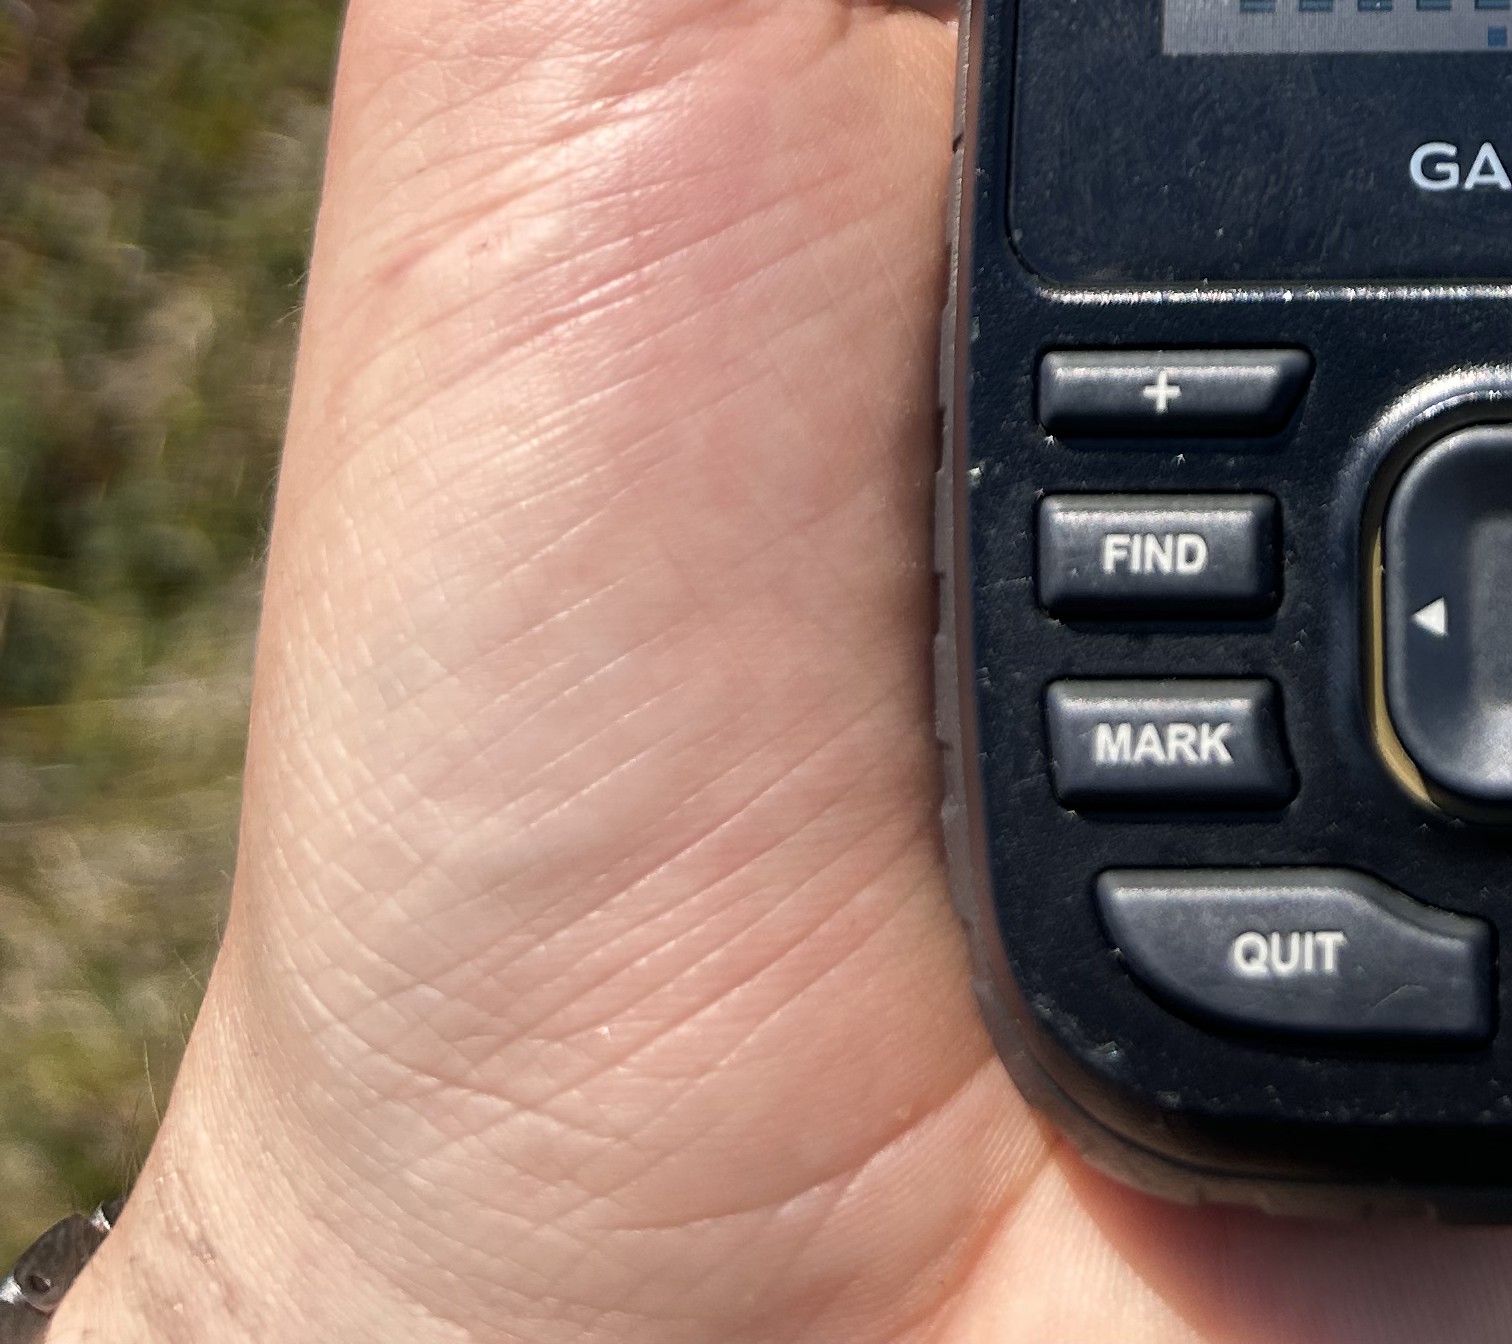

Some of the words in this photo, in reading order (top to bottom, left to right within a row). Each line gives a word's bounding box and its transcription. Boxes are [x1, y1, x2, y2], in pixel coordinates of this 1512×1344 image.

[1102, 533, 1209, 576] FIND
[1094, 721, 1234, 766] MARK
[1231, 930, 1345, 978] QUIT
